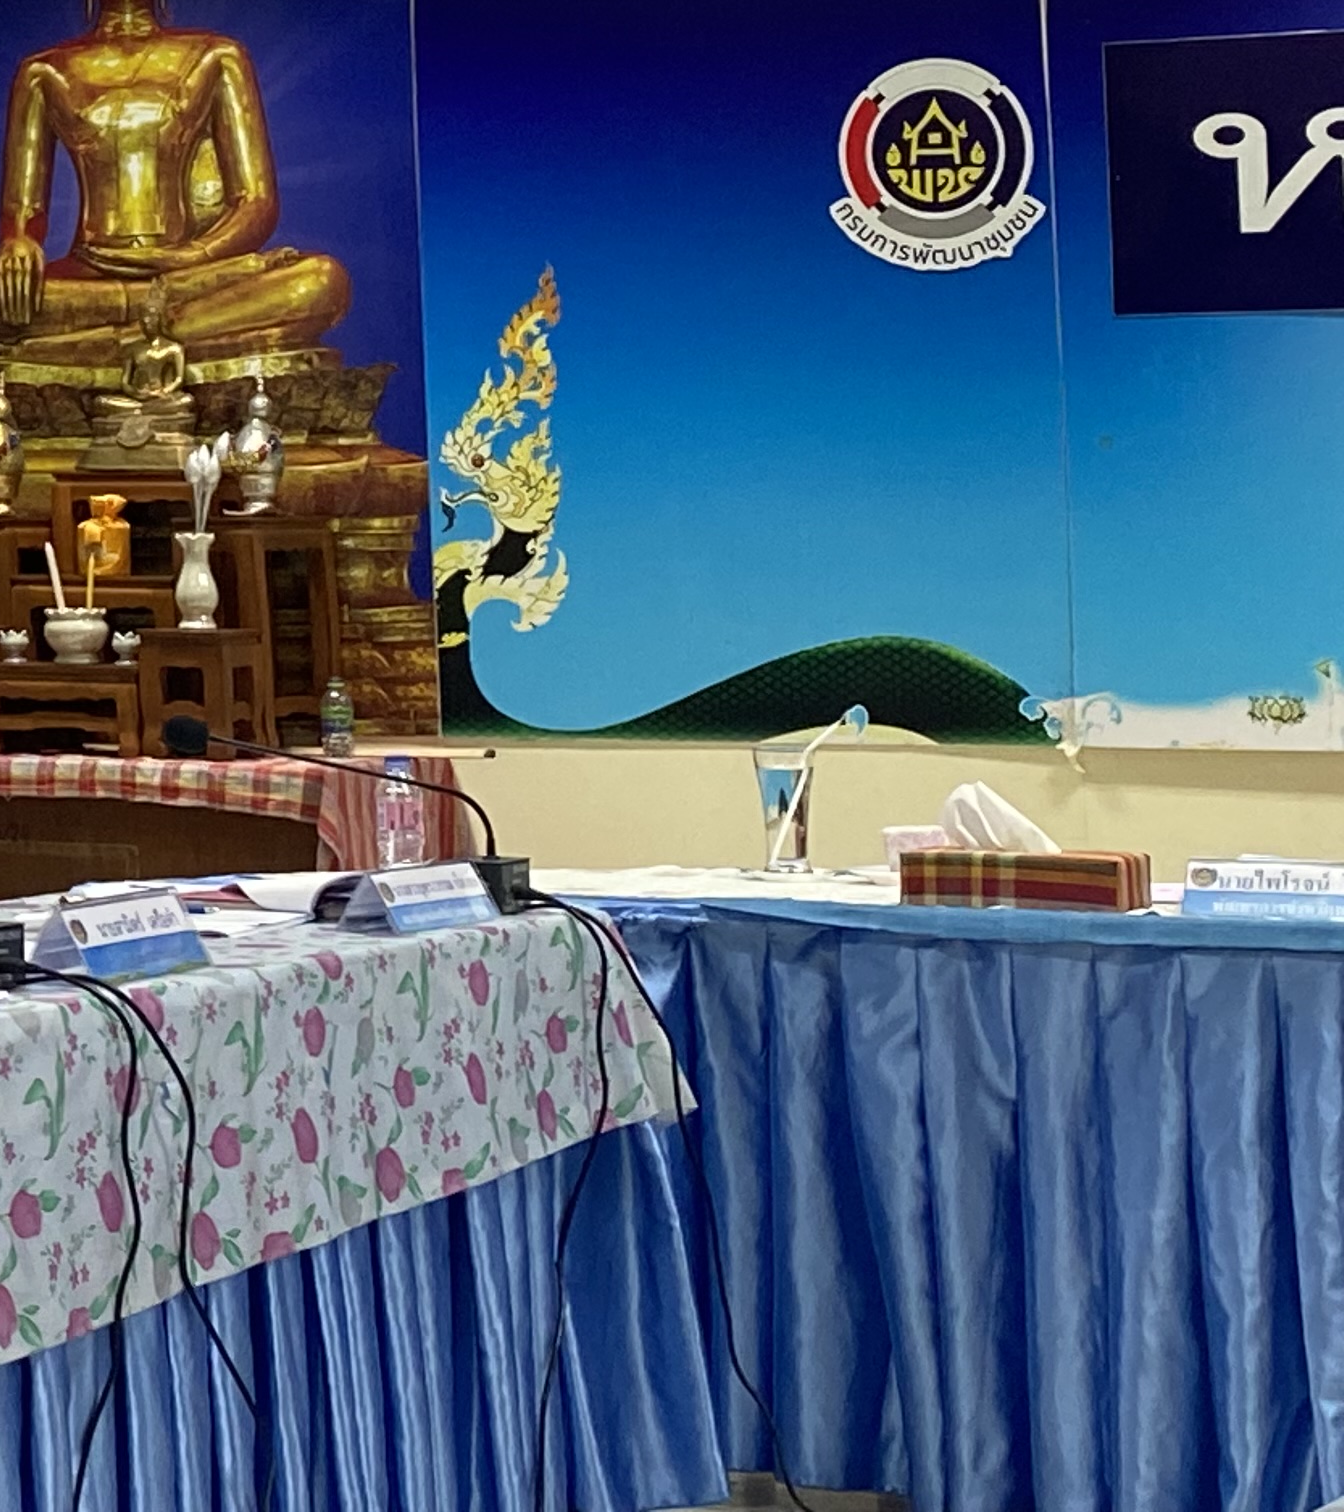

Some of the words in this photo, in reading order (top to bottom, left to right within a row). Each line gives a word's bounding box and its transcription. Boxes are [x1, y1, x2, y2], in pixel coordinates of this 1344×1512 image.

[835, 200, 1040, 265] กรมการพัฒนาชุมชน
